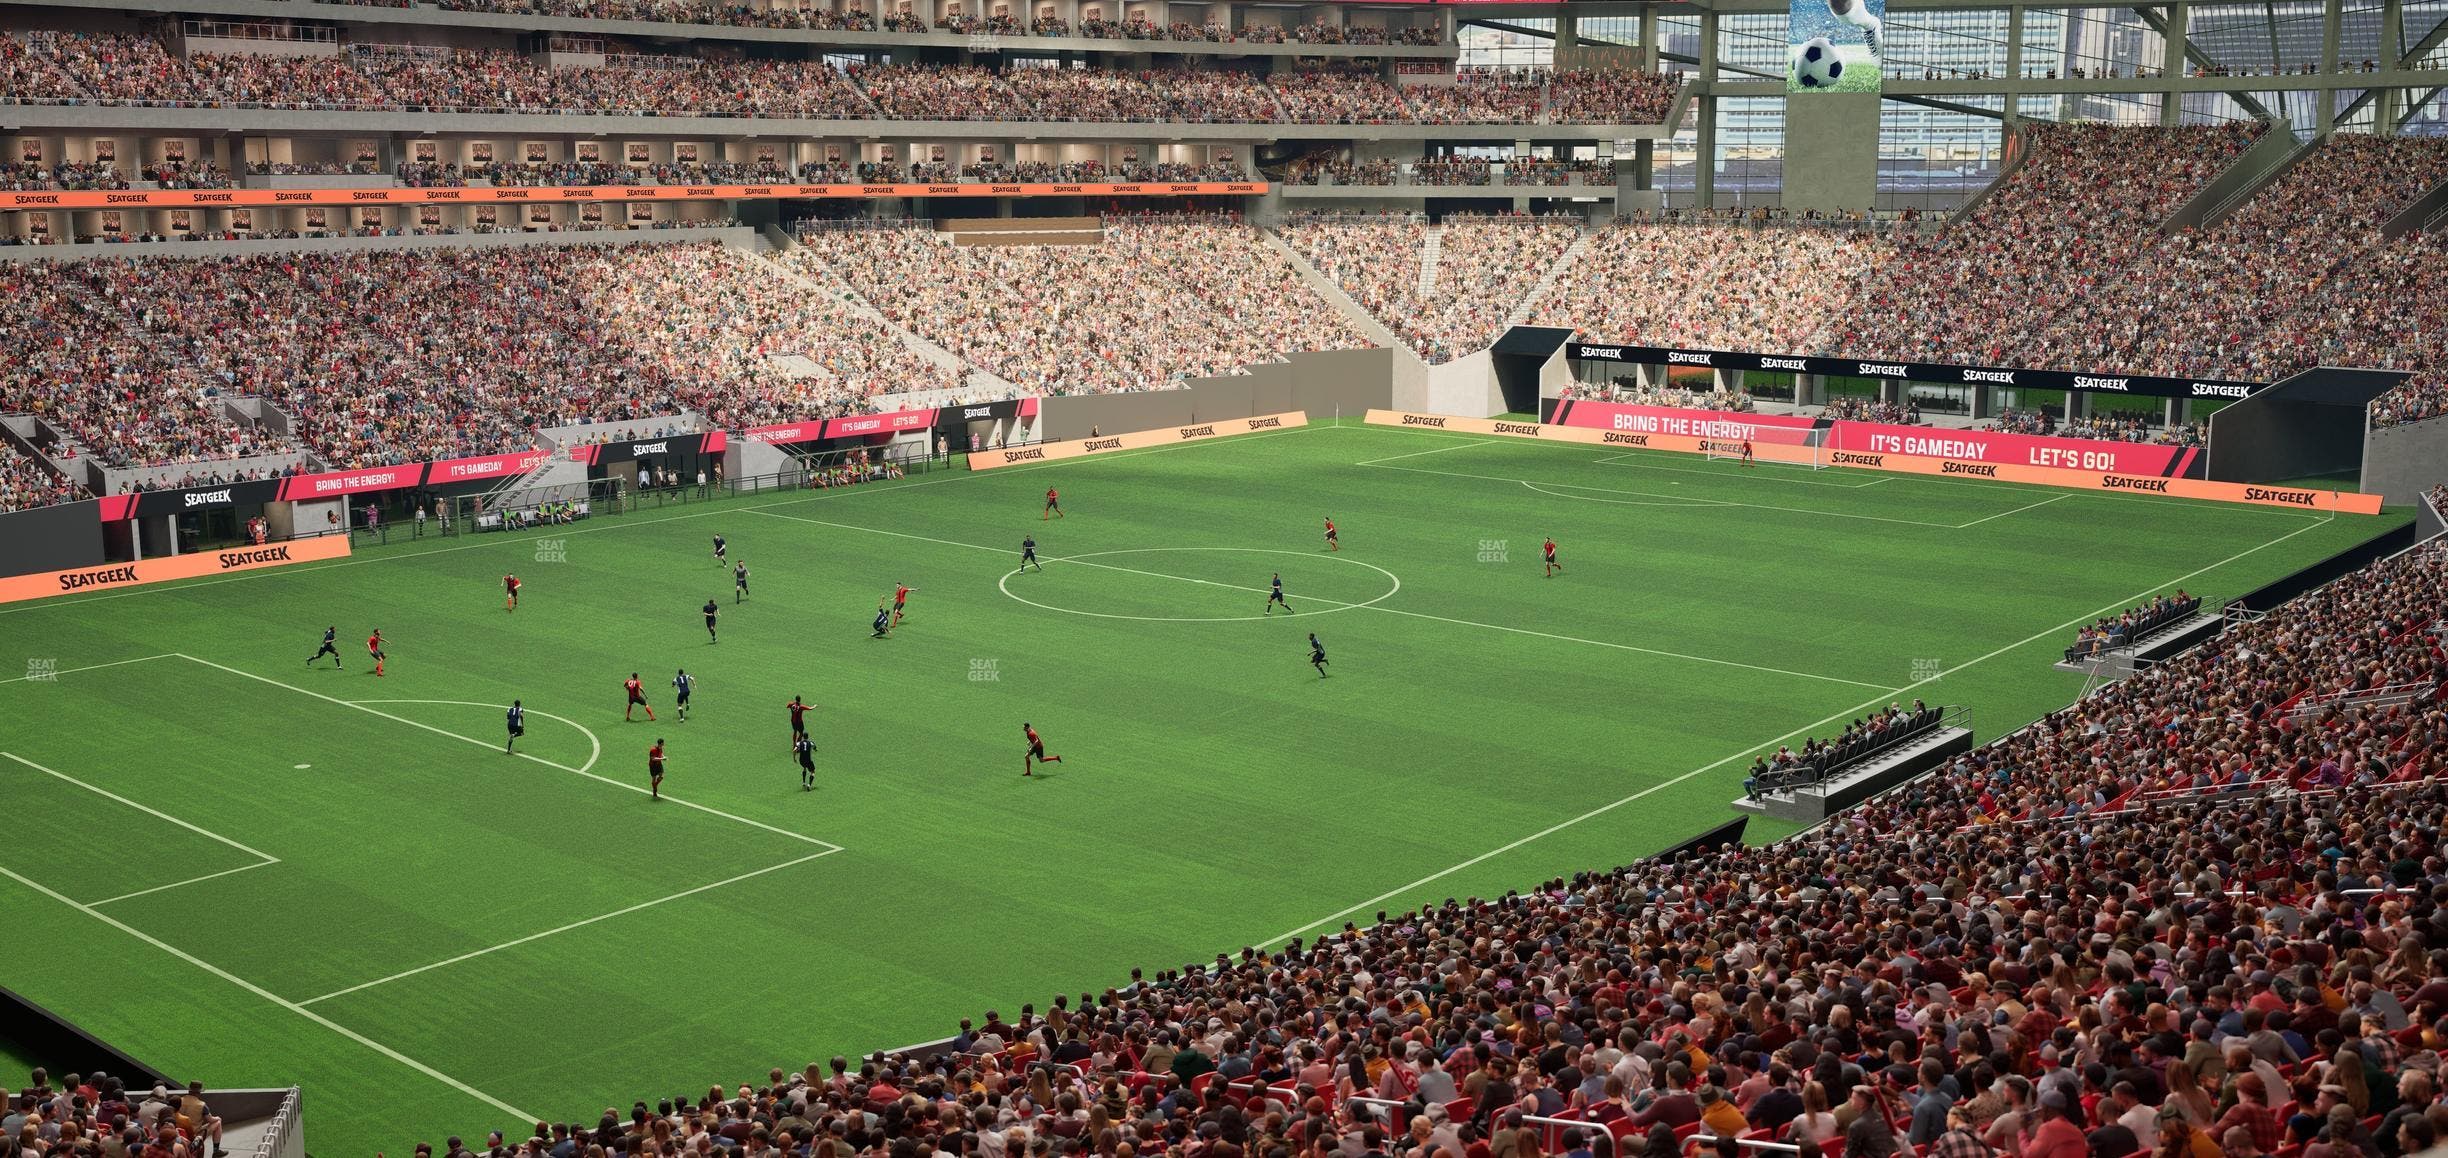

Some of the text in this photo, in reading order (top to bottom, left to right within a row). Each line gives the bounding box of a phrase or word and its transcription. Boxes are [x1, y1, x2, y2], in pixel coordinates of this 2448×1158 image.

[15, 195, 59, 204] SEATGEEK
[107, 194, 148, 203] SEATGEEK
[194, 193, 232, 202] SEATGEEK
[276, 193, 312, 201] SEATGEEK
[353, 192, 388, 200] SEATGEEK
[427, 191, 460, 199] SEATGEEK
[497, 191, 528, 199] SEATGEEK
[563, 190, 593, 198] SEATGEEK
[627, 189, 655, 197] SEATGEEK
[687, 188, 714, 196] SEATGEEK
[1581, 346, 2250, 398] SEATGEEK SEATGEEK SEATGEEK SEATGEEK SEATGEEK SEATGEEK SEATGEEK
[893, 415, 918, 427] LET'S GO!
[964, 406, 991, 419] SEATGEEK
[775, 428, 801, 440] ENERGY!
[842, 419, 881, 433] IT'S GAMEDAY
[1614, 413, 1755, 441] BRING THE ENERGY!
[1004, 416, 1281, 463] SEATGEEK SEATGEEK SEATGEEK SEATGEEK
[1870, 434, 1988, 460] IT'S GAMEDAY
[633, 441, 668, 457] SEATGEEK
[1402, 414, 1446, 428] SEATGEEK
[1494, 422, 1540, 436] SEATGEEK
[1603, 431, 1648, 446] SEATGEEK
[1832, 451, 1884, 467] SEATGEEK
[1942, 461, 1997, 478] SEATGEEK
[2102, 475, 2169, 493] SEATGEEK
[2244, 487, 2316, 506] SEATGEEK
[2029, 447, 2115, 471] LET'S GO!
[451, 461, 502, 477] IT'S GAMEDAY
[316, 473, 395, 492] BRING THE ENERGY!
[185, 489, 232, 507] SEATGEEK
[59, 545, 292, 591] SEATGEEK SEATGEEK
